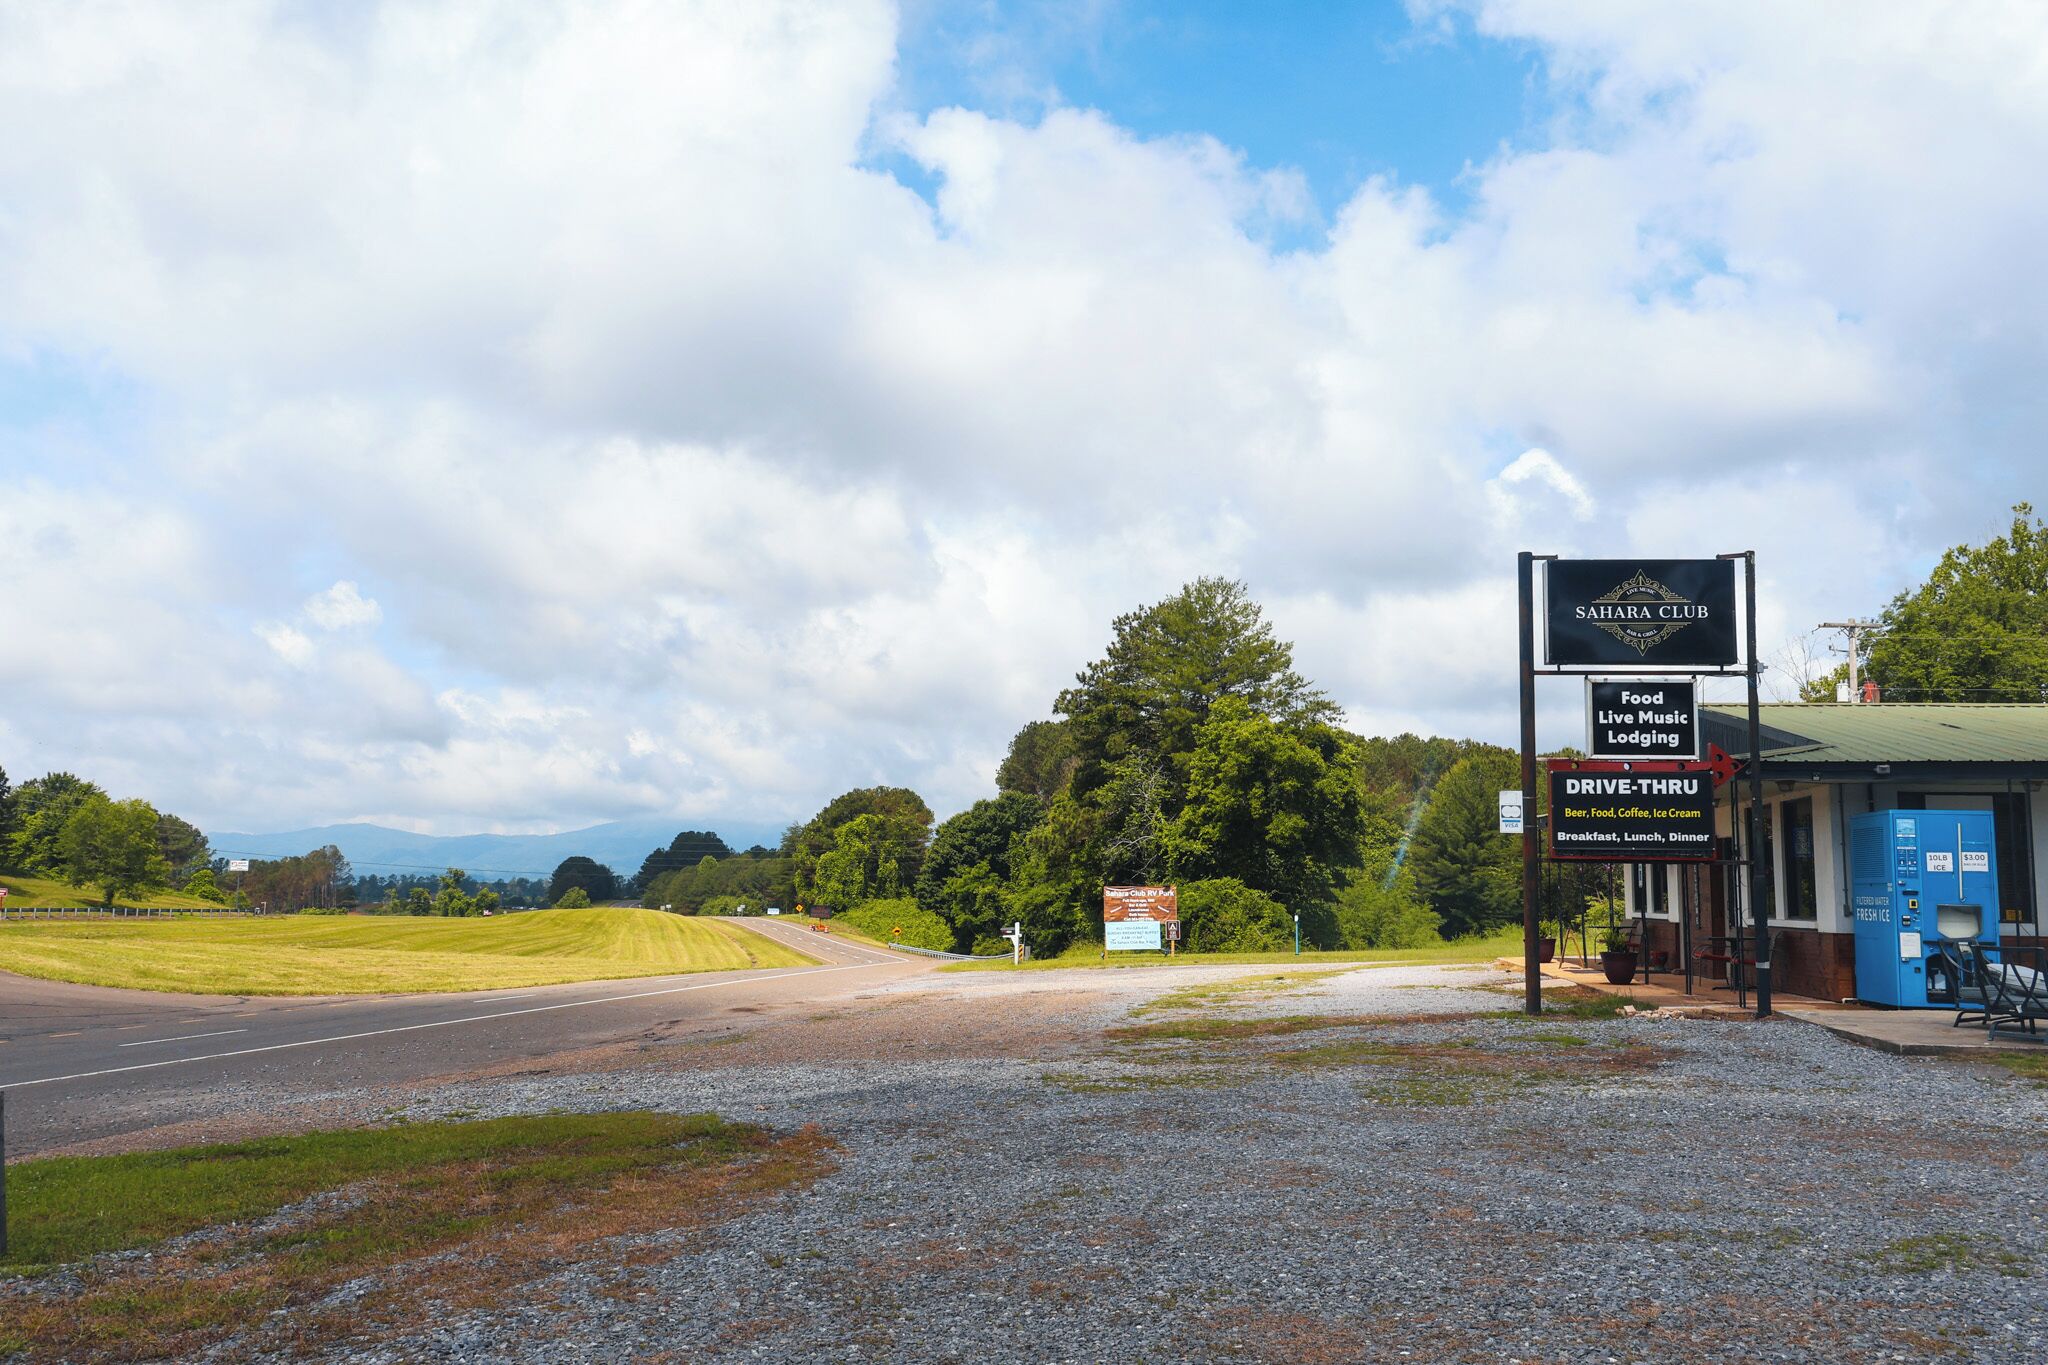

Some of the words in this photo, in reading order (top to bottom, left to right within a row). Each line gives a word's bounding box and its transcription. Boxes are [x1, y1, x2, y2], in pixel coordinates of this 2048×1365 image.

[1626, 587, 1638, 596] LIVE
[1639, 587, 1656, 595] MUSIC
[1575, 605, 1651, 619] SAHARA
[1658, 605, 1709, 619] CLUB
[1626, 628, 1636, 637] BAR
[1642, 629, 1658, 637] GRILL
[1621, 691, 1664, 705] Food
[1598, 710, 1634, 724] Live
[1638, 710, 1688, 724] Music
[1608, 730, 1679, 747] Lodging
[1566, 779, 1698, 795] DRIVE-THRU
[1564, 807, 1589, 819] Beer,
[1591, 807, 1617, 819] Food,
[1618, 808, 1652, 819] Coffee,
[1653, 808, 1668, 818] Ice
[1669, 808, 1701, 818] Cream
[1557, 831, 1621, 843] Breakfast,
[1624, 831, 1666, 843] Lunch,
[1669, 832, 1709, 842] Dinner
[1856, 896, 1873, 906] FILTERED
[1874, 896, 1889, 906] WATER
[1856, 908, 1877, 921] FRESH
[1878, 910, 1890, 922] ICE
